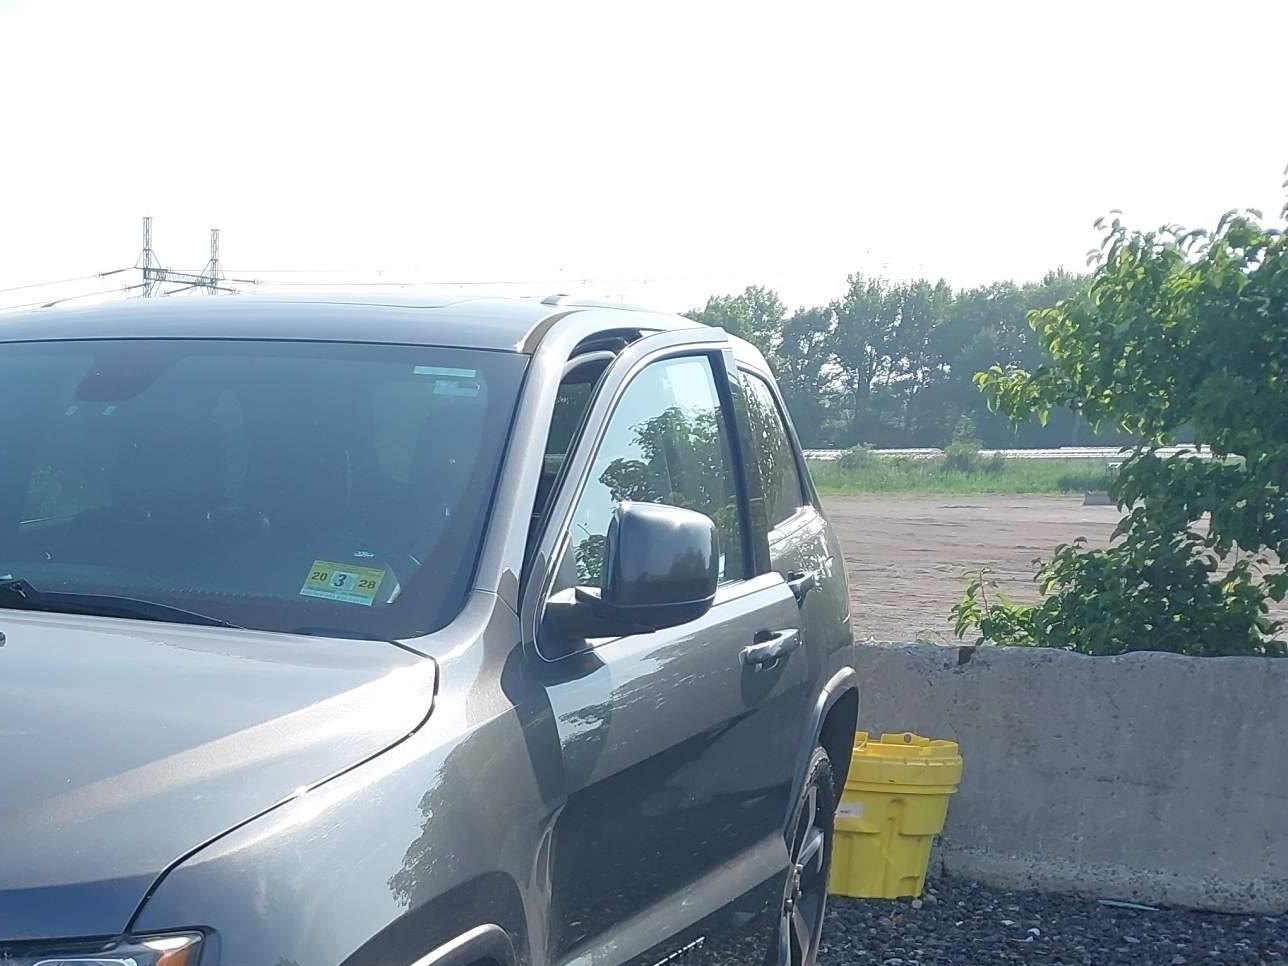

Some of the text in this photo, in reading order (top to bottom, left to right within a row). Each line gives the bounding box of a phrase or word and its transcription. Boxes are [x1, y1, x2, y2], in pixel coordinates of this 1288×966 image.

[311, 571, 377, 589] 20 3 28
